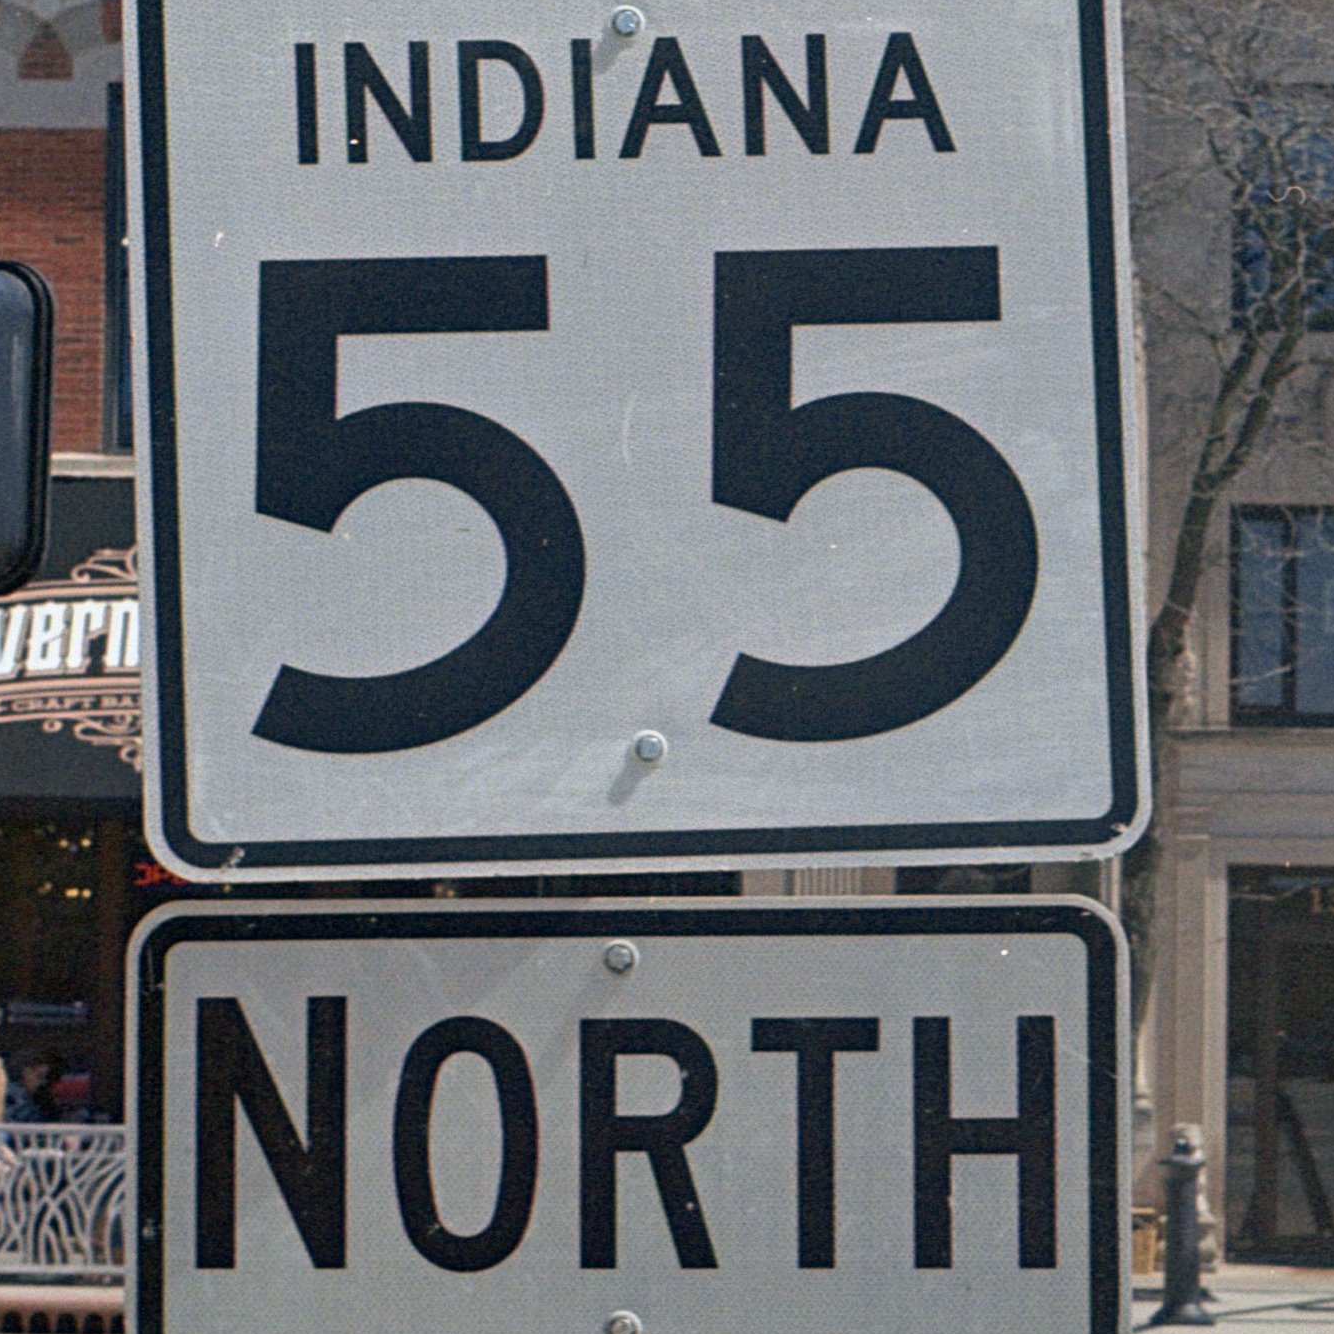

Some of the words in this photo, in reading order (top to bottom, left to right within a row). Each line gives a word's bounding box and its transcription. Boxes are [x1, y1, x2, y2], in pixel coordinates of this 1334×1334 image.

[295, 33, 955, 164] INDIANA
[252, 246, 1038, 754] 55
[101, 694, 141, 708] BA
[195, 996, 1057, 1273] NORTH
